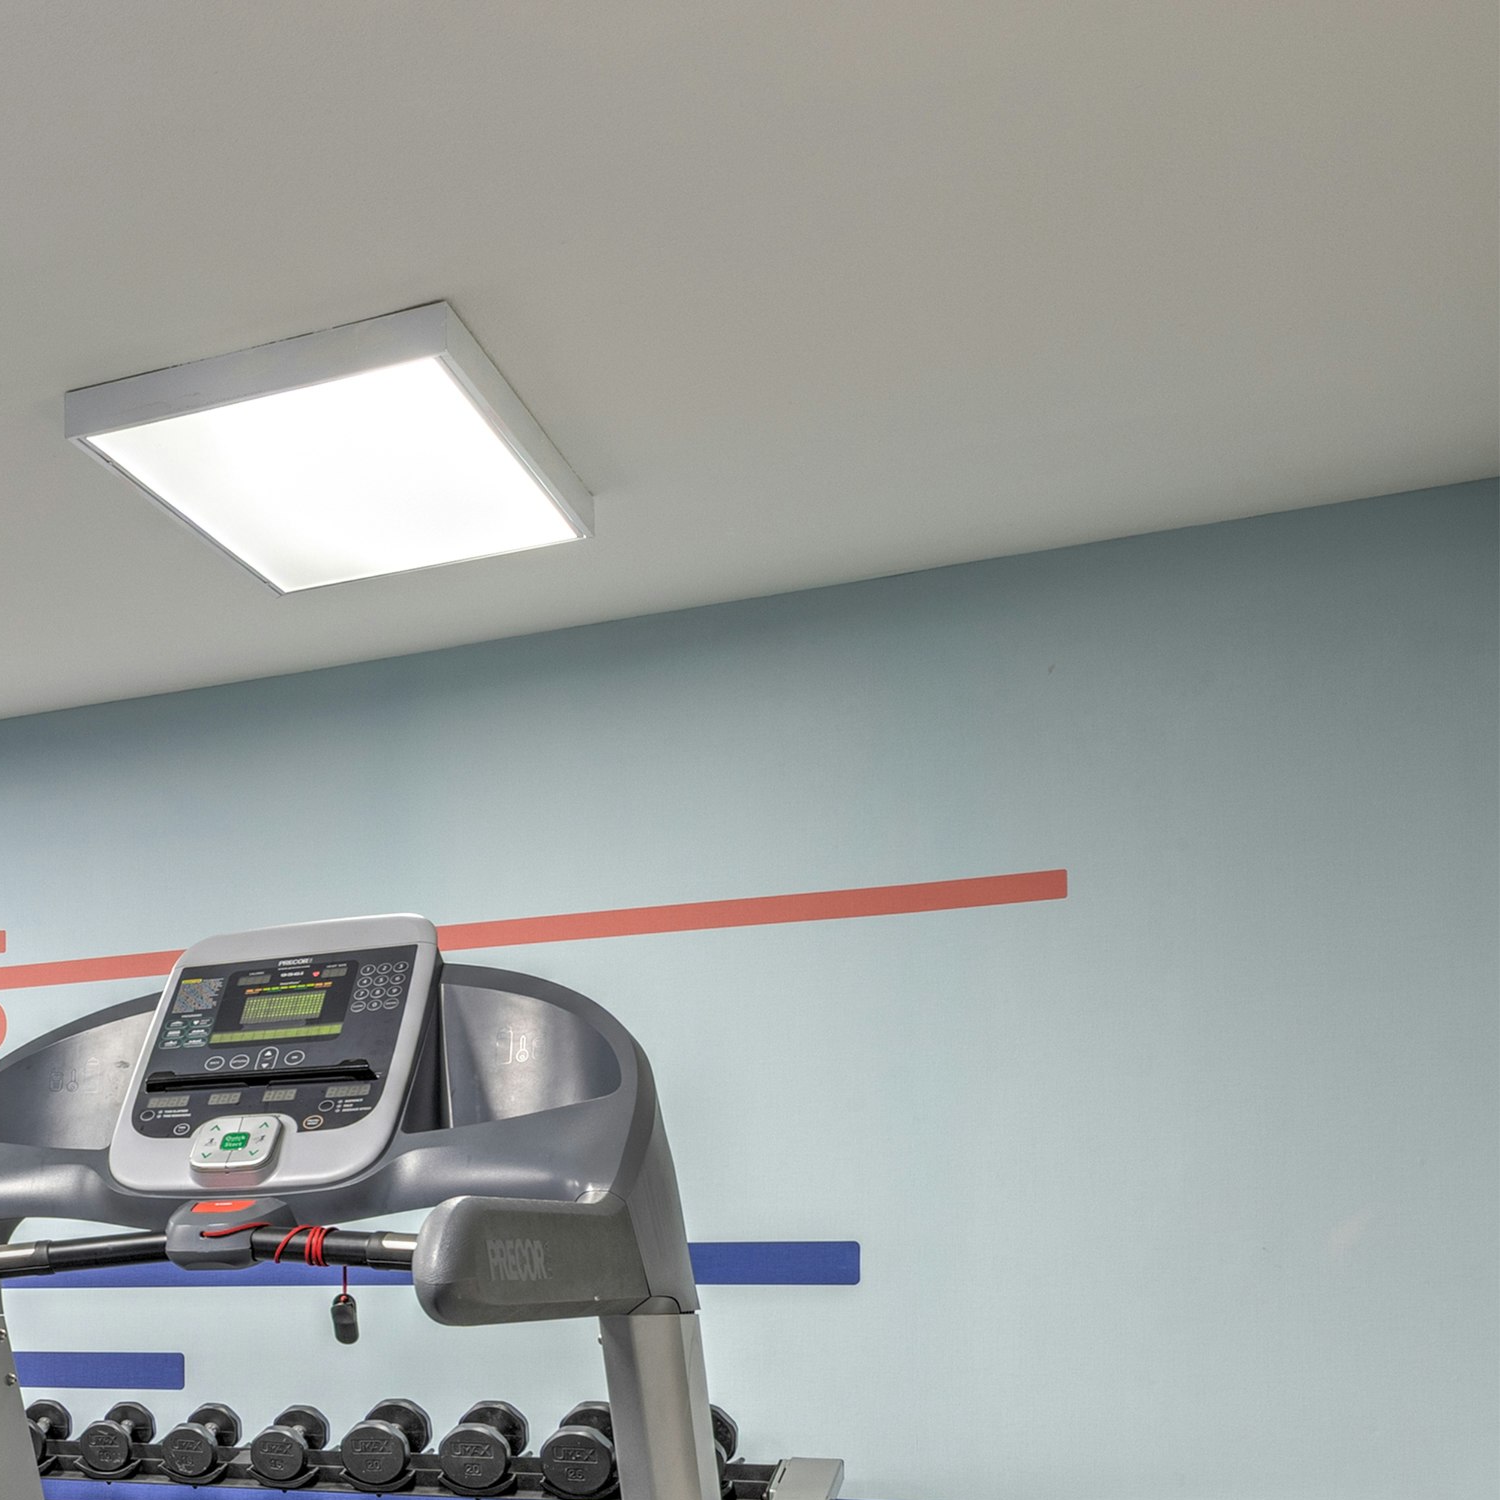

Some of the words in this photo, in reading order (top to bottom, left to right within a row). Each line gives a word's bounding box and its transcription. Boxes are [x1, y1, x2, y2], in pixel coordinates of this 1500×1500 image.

[486, 1238, 547, 1281] PRECOR
[351, 1438, 393, 1452] UMAX
[450, 1442, 494, 1456] UMAX
[552, 1447, 598, 1461] UMAX
